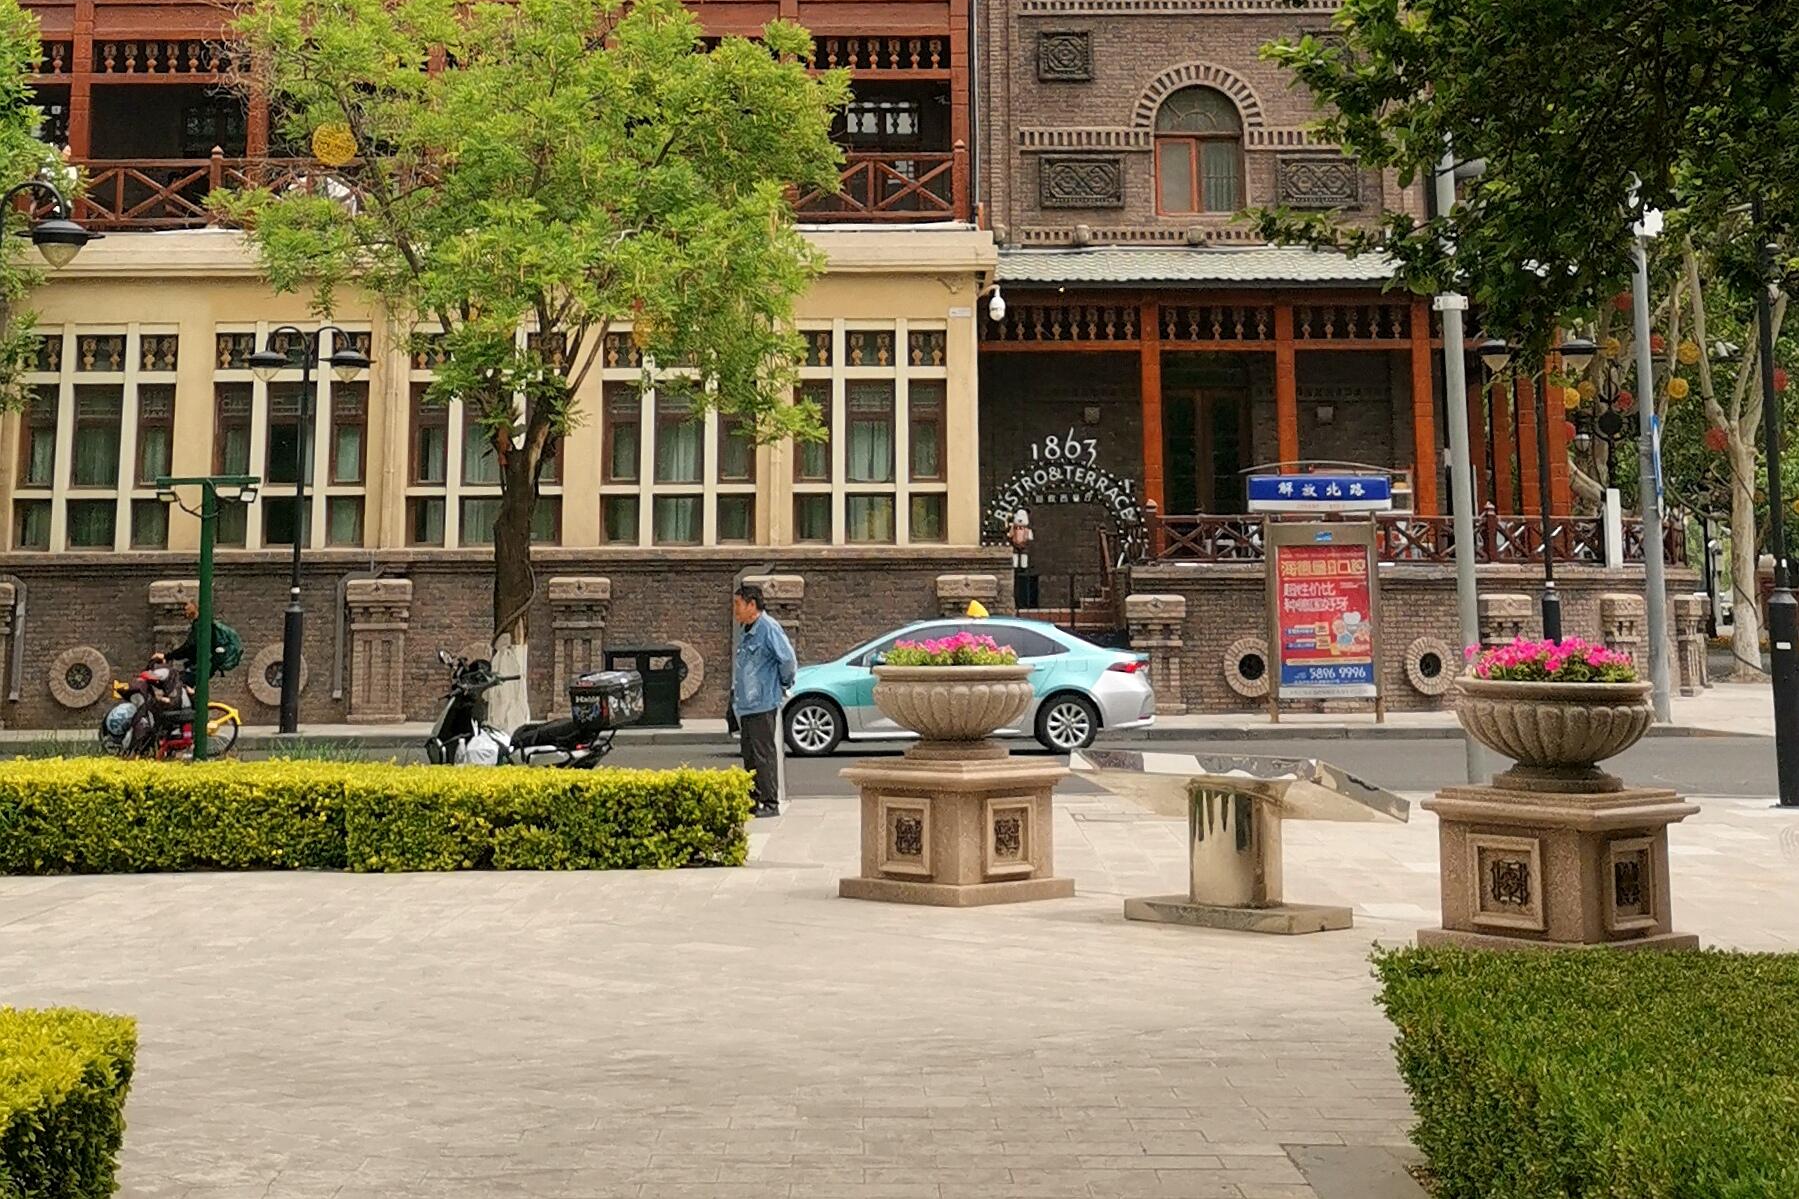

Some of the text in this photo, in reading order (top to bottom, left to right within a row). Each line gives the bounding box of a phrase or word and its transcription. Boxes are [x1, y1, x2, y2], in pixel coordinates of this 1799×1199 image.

[1031, 427, 1097, 467] 1863
[1277, 481, 1366, 497] 解放北路
[1339, 666, 1366, 678] 9996
